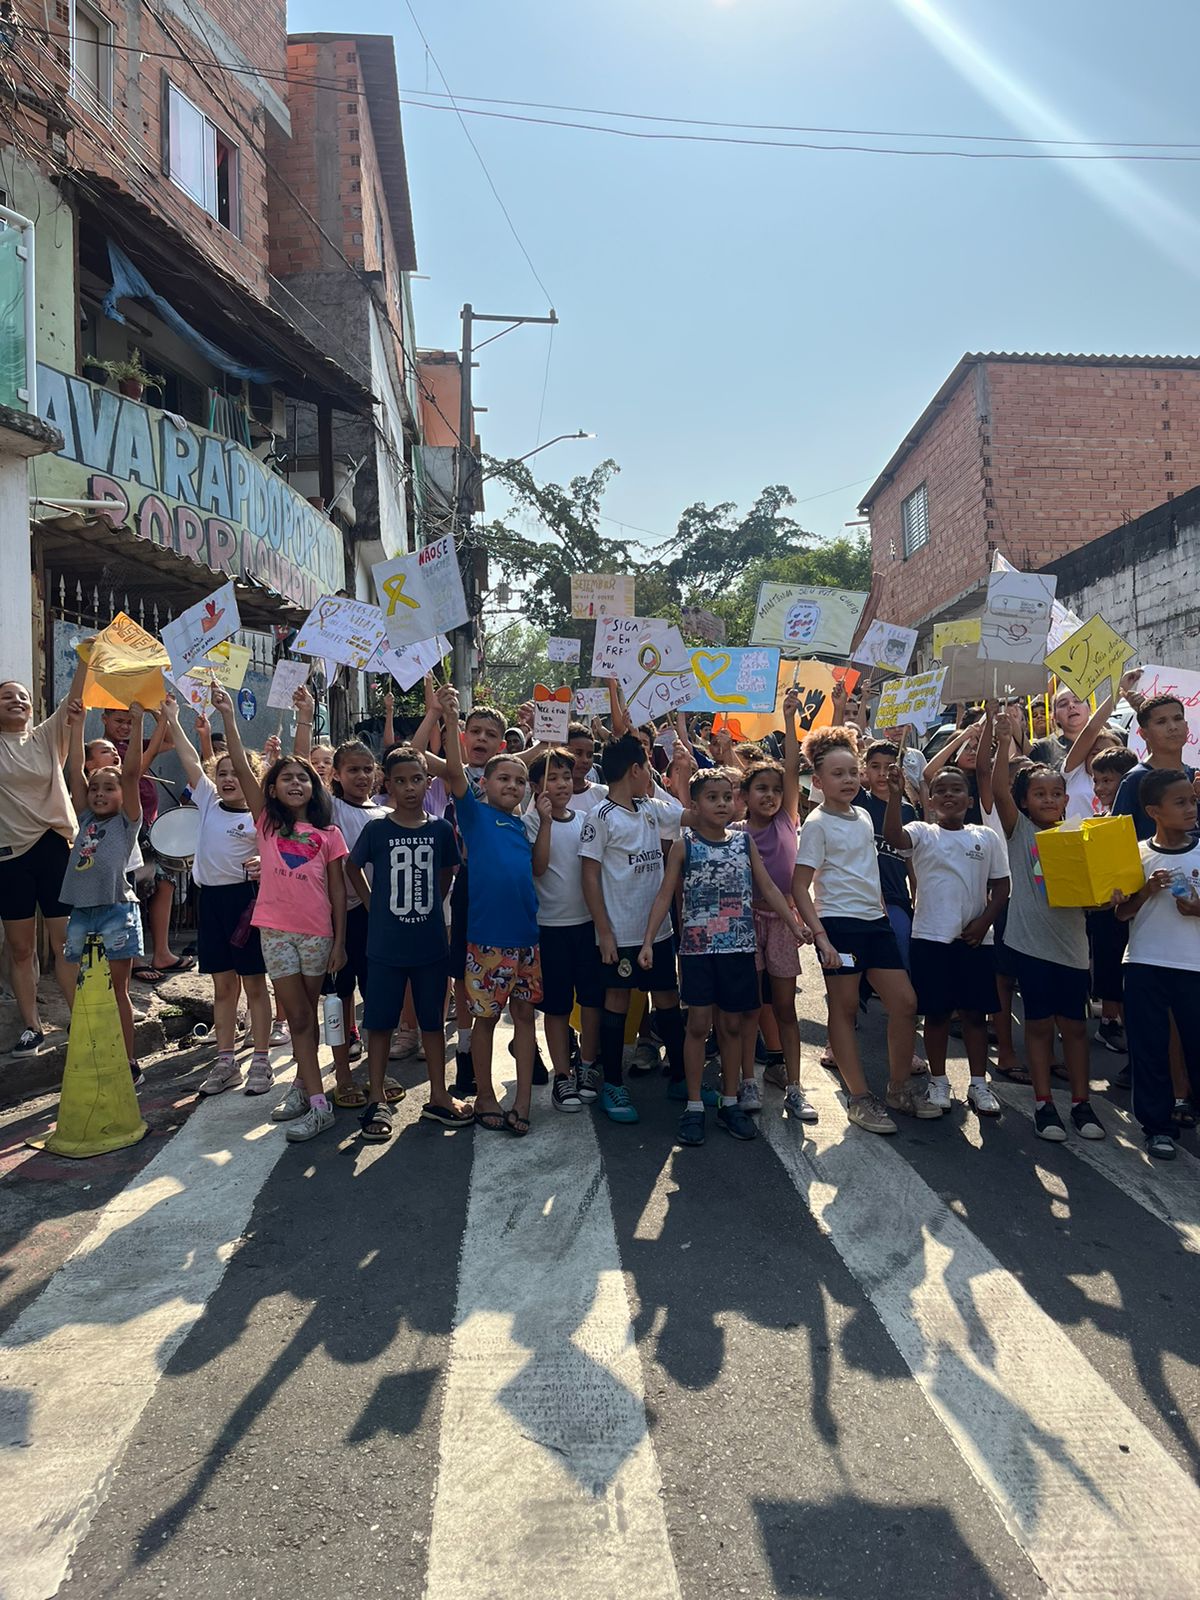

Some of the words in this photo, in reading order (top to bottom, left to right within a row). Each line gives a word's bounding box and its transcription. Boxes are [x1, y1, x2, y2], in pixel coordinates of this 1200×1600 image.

[36, 362, 158, 491] AVA
[613, 620, 639, 632] SIGA
[388, 837, 435, 847] BROOKLYN
[389, 844, 434, 916] 89
[398, 915, 428, 924] MMXVII
